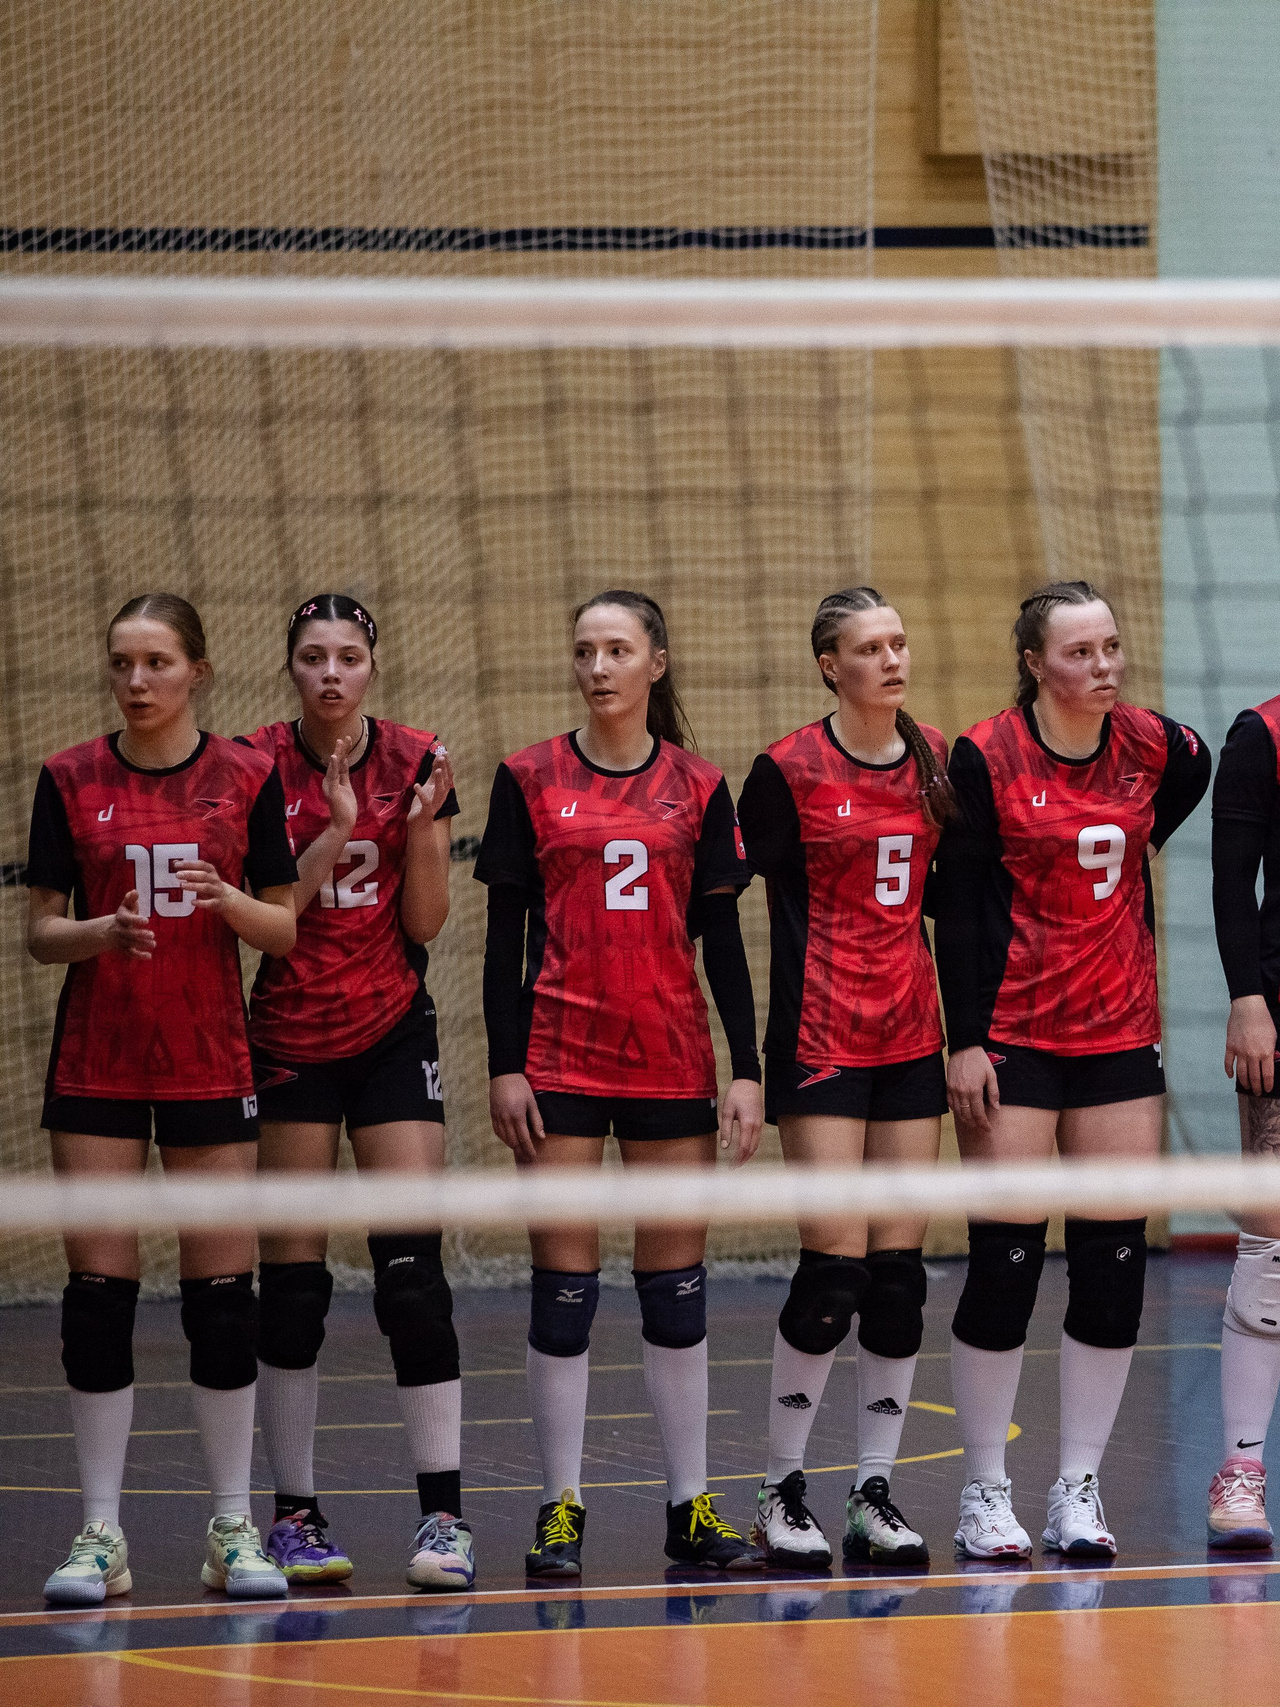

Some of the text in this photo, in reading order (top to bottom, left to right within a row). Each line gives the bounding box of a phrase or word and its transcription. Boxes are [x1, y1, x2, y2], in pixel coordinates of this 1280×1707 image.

[125, 843, 199, 918] 15
[603, 838, 649, 911] 2
[874, 834, 914, 906] 5
[1078, 823, 1127, 901] 9
[778, 1396, 812, 1410] adidas
[866, 1403, 903, 1416] adidas
